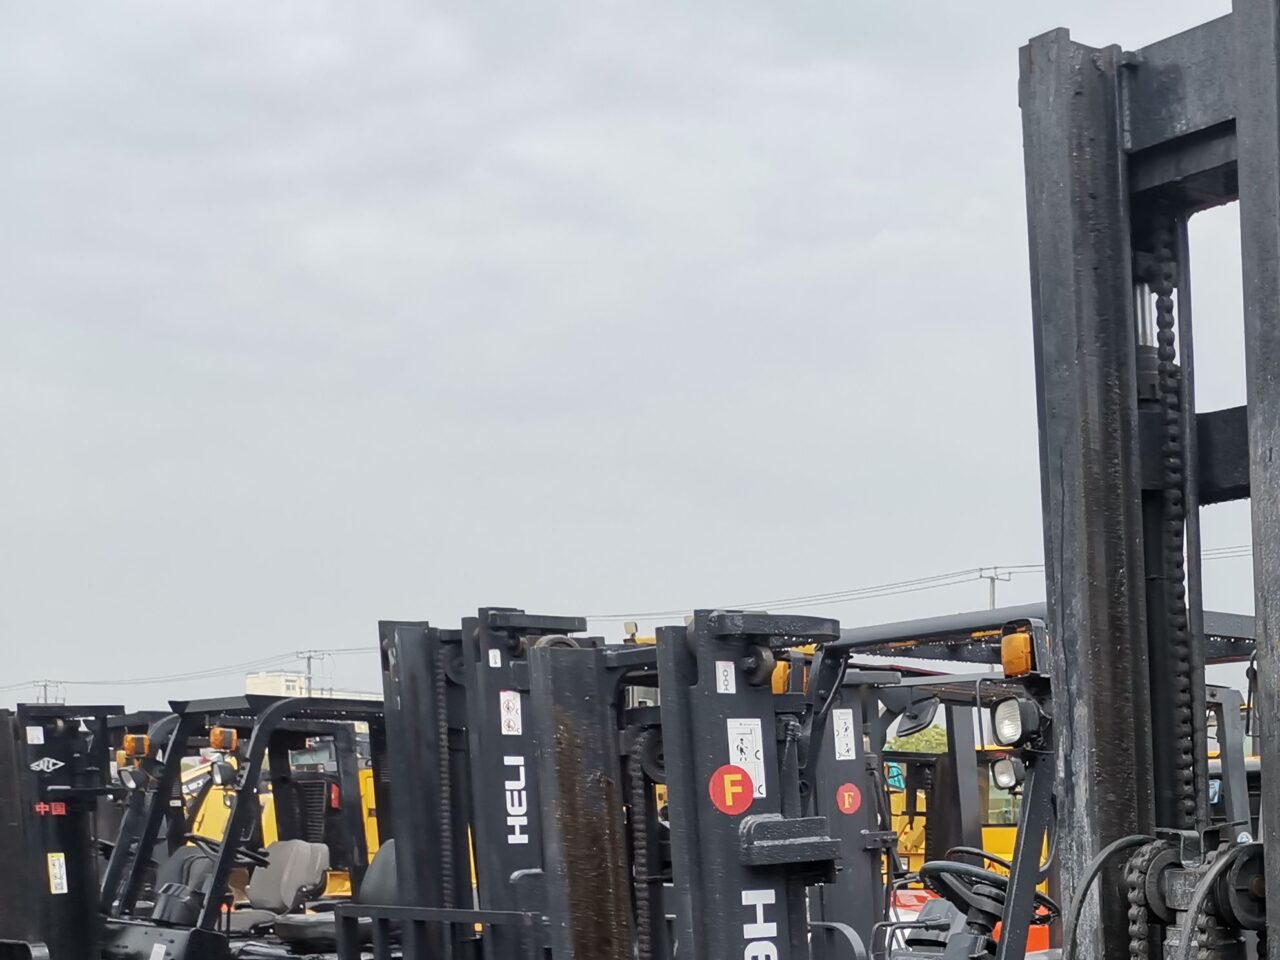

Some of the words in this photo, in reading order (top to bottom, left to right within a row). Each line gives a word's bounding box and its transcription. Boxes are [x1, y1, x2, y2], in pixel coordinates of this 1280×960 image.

[503, 756, 529, 844] HELI
[723, 774, 743, 807] F
[843, 792, 854, 809] F
[35, 802, 66, 815] 中国
